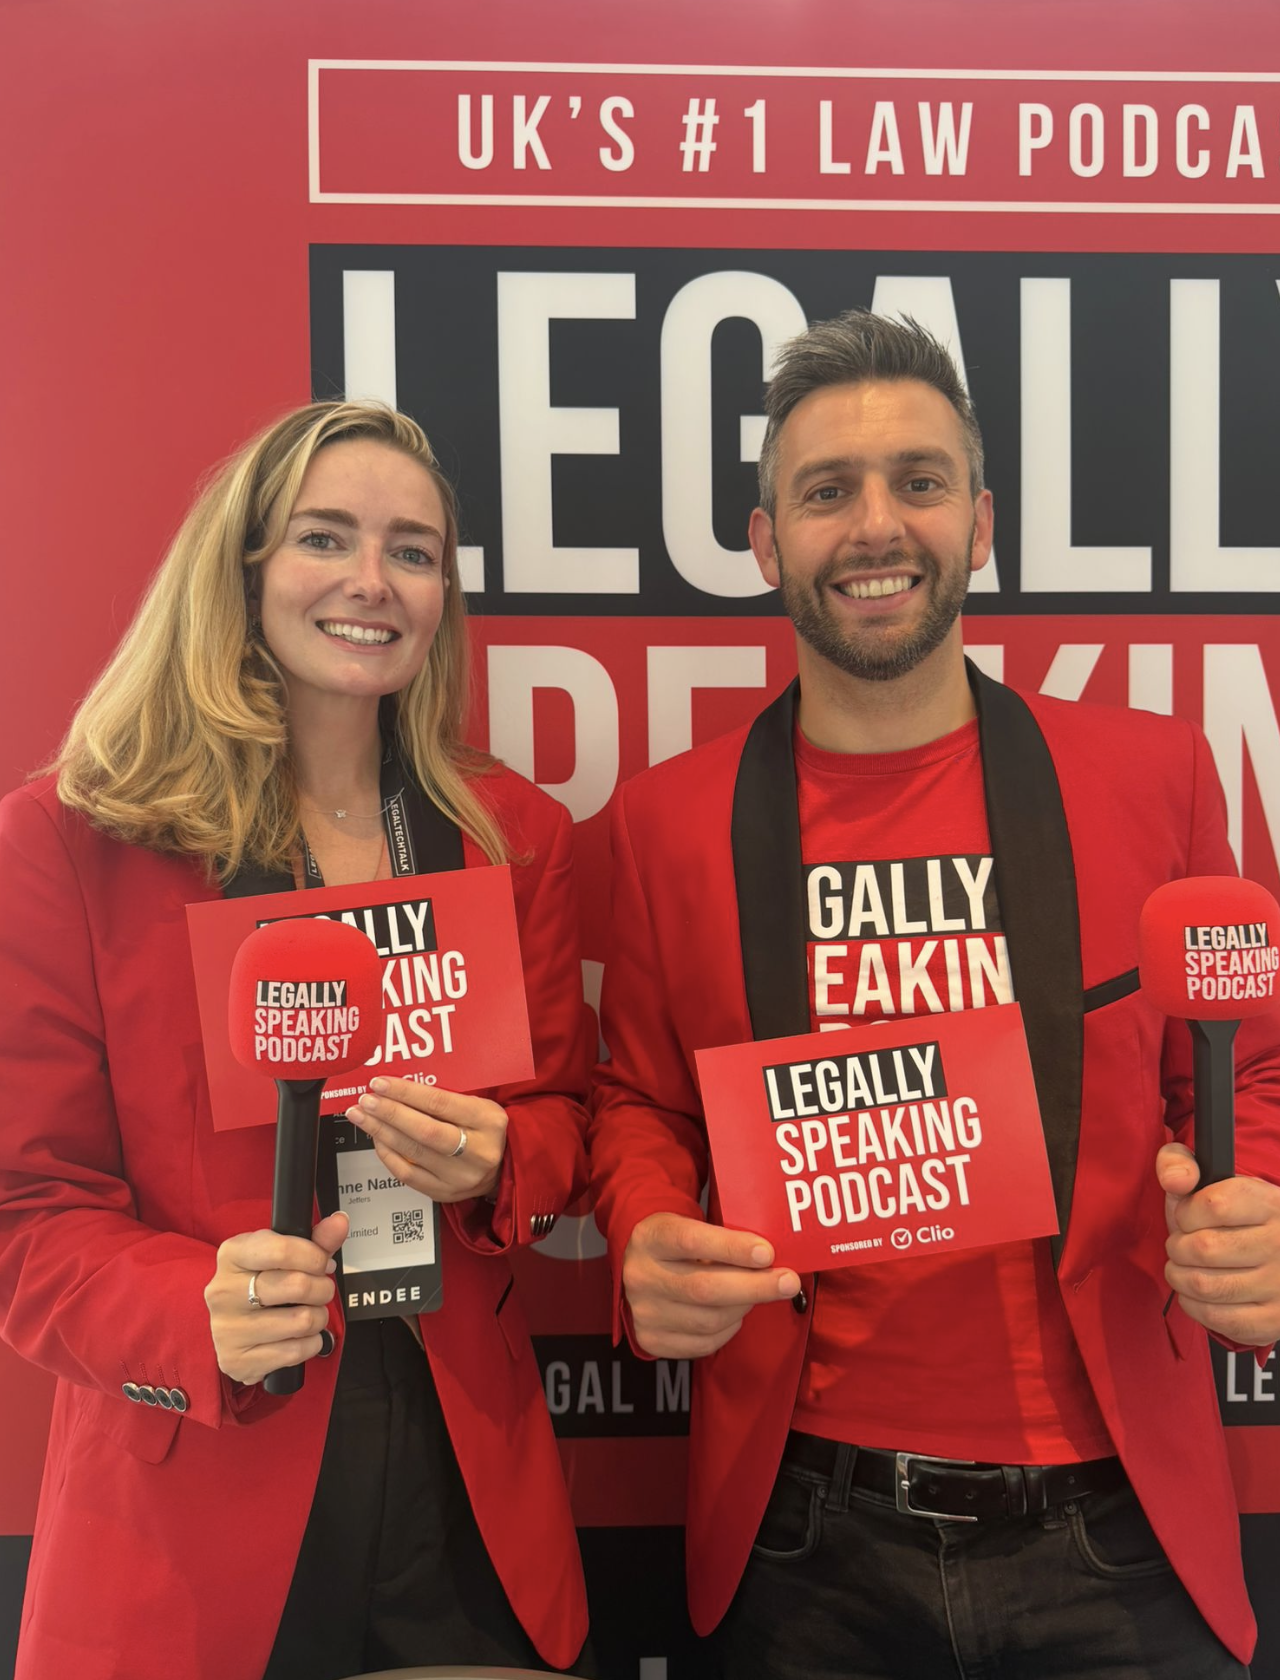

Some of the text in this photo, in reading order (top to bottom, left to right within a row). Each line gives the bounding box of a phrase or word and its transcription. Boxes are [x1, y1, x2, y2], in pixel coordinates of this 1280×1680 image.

[458, 94, 1266, 179] UK'S #1 LAW PODCA
[806, 857, 994, 939] GALLY
[1184, 922, 1267, 950] LEGALLY
[807, 935, 1015, 1017] EAKIN
[1185, 946, 1279, 976] SPEAKING
[256, 980, 346, 1009] LEGALLY
[1186, 972, 1275, 1001] PODCAST
[254, 1006, 360, 1037] SPEAKING
[254, 1033, 353, 1063] PODCAST
[357, 1085, 367, 1095] BY
[765, 1045, 935, 1120] LEGALLY
[775, 1096, 983, 1176] SPEAKING
[785, 1154, 971, 1232] PODCAST
[830, 1224, 955, 1254] SPONSORED BY Clio
[348, 1286, 421, 1308] ENDEE
[545, 1359, 634, 1415] GAL
[1227, 1350, 1276, 1402] LE
